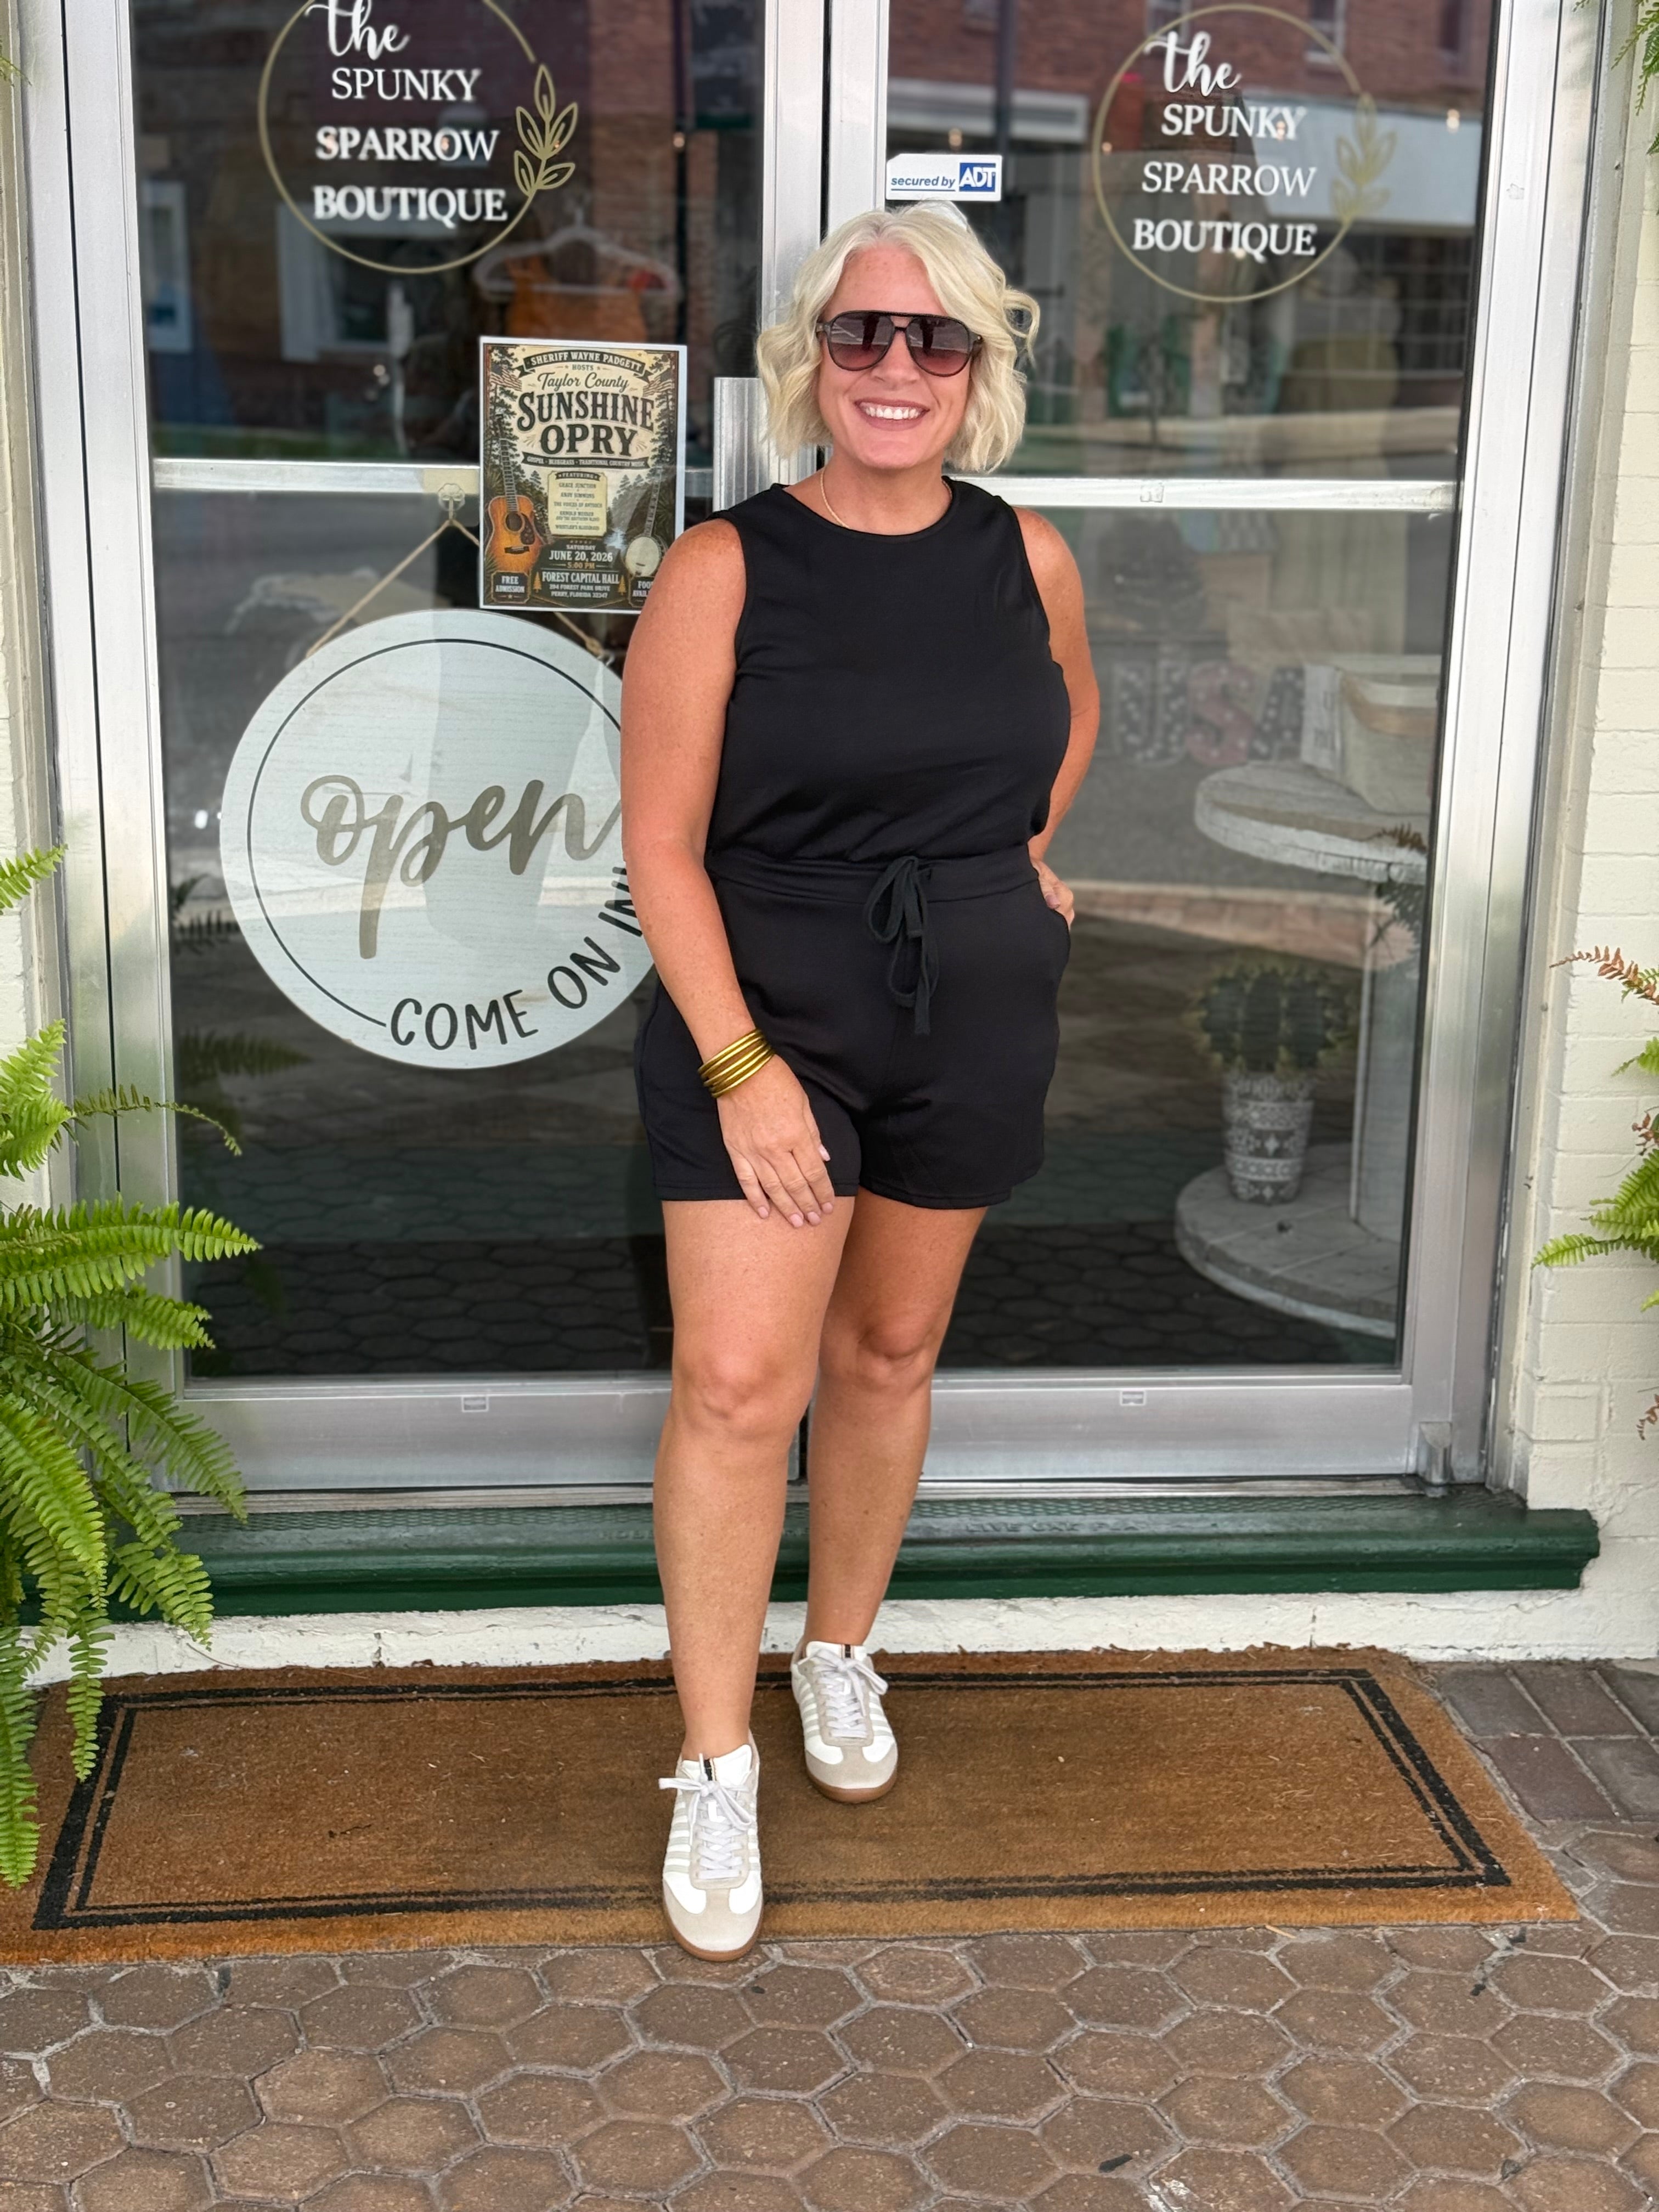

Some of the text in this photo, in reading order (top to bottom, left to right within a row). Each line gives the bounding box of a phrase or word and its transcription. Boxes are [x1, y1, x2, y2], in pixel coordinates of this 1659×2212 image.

[304, 0, 410, 60] the
[1143, 31, 1242, 97] the
[331, 67, 482, 101] SPUNKY
[1161, 103, 1307, 140] SPUNKY
[315, 126, 500, 161] SPARROW
[890, 166, 996, 188] secured by ADT
[1141, 160, 1317, 197] SPARROW
[311, 184, 509, 229] BOUTIQUE
[1132, 218, 1317, 262] BOUTIQUE
[531, 351, 642, 372] SHERIFF WAYNE PADGETT
[537, 371, 630, 393] Taylor County
[517, 390, 654, 432] SUNSHINE
[539, 424, 638, 457] OPRY
[549, 550, 613, 562] JUNE 20, 2026
[501, 575, 519, 585] FREE
[542, 571, 620, 584] FOREST CAPITAL HALL
[637, 580, 652, 589] FOO
[301, 775, 622, 960] open
[391, 989, 539, 1050] COME
[547, 936, 621, 1009] ON
